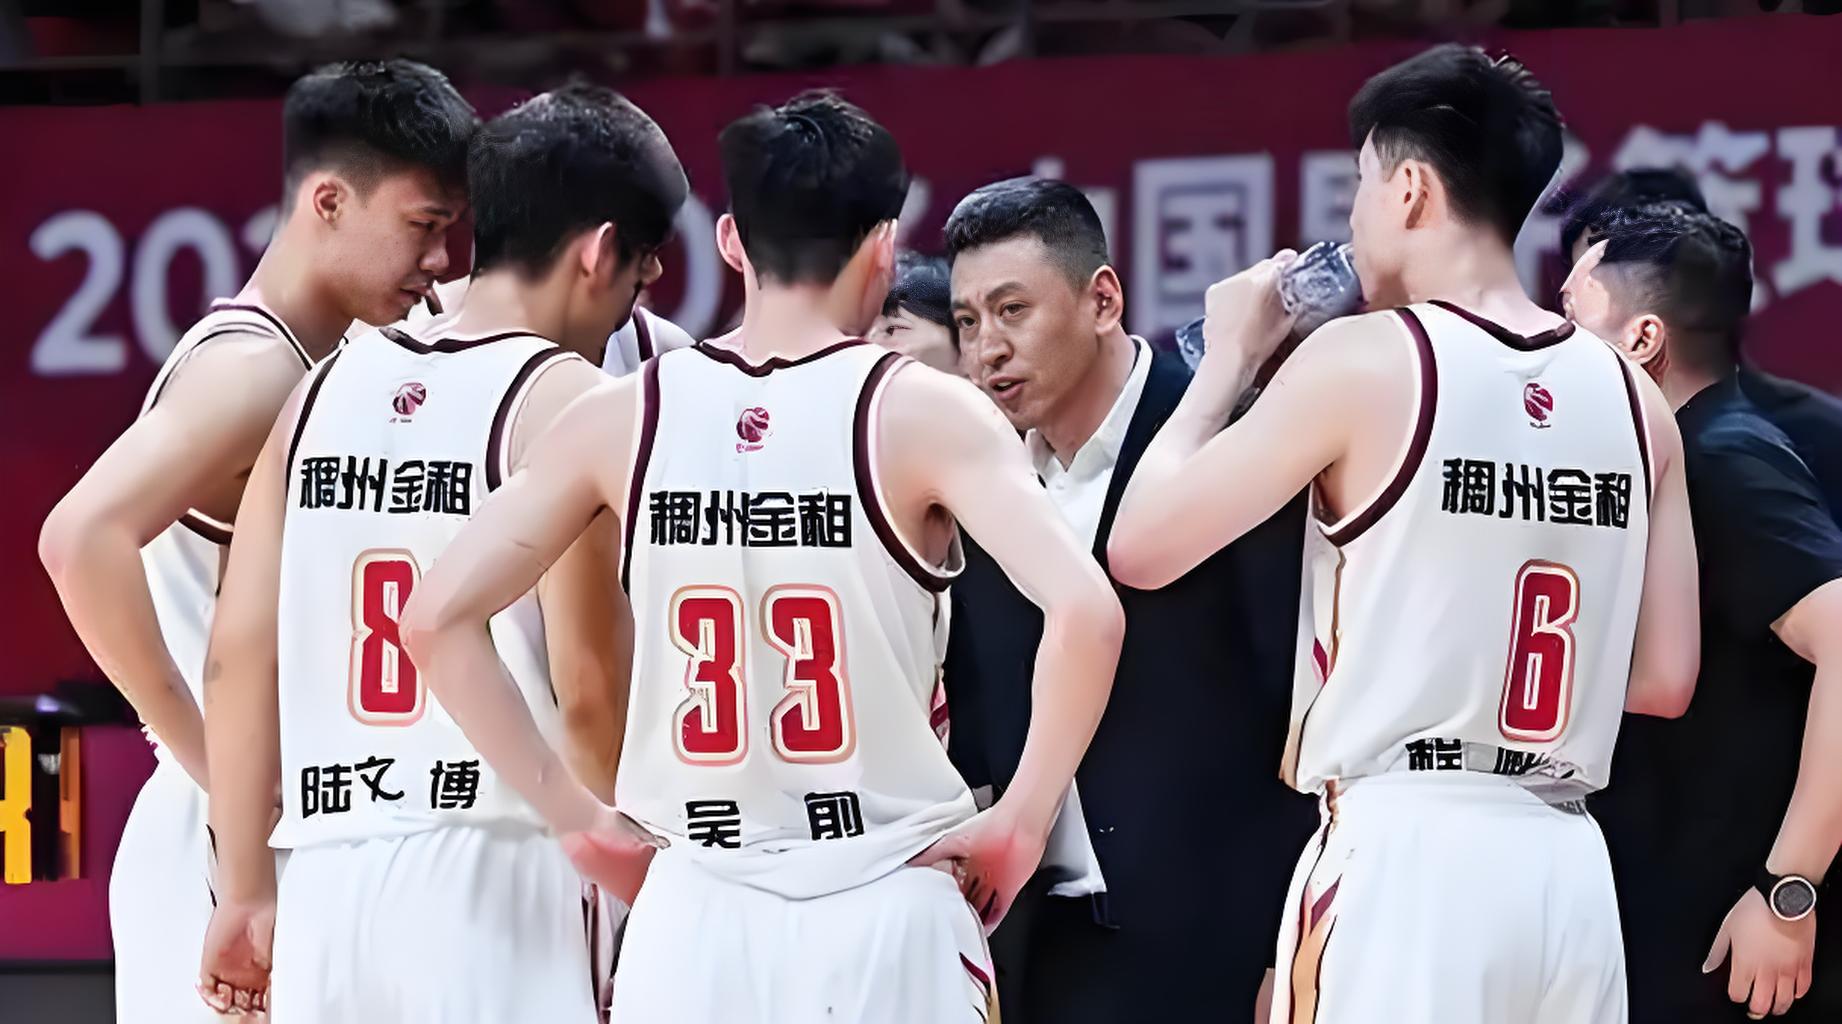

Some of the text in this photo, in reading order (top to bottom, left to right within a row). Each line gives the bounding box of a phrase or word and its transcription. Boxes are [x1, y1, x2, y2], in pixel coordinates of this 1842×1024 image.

[299, 455, 473, 516] 稠州金租
[649, 489, 852, 548] 稠州金租
[348, 548, 428, 727] 8
[669, 584, 857, 767] 33
[1499, 559, 1581, 743] 6
